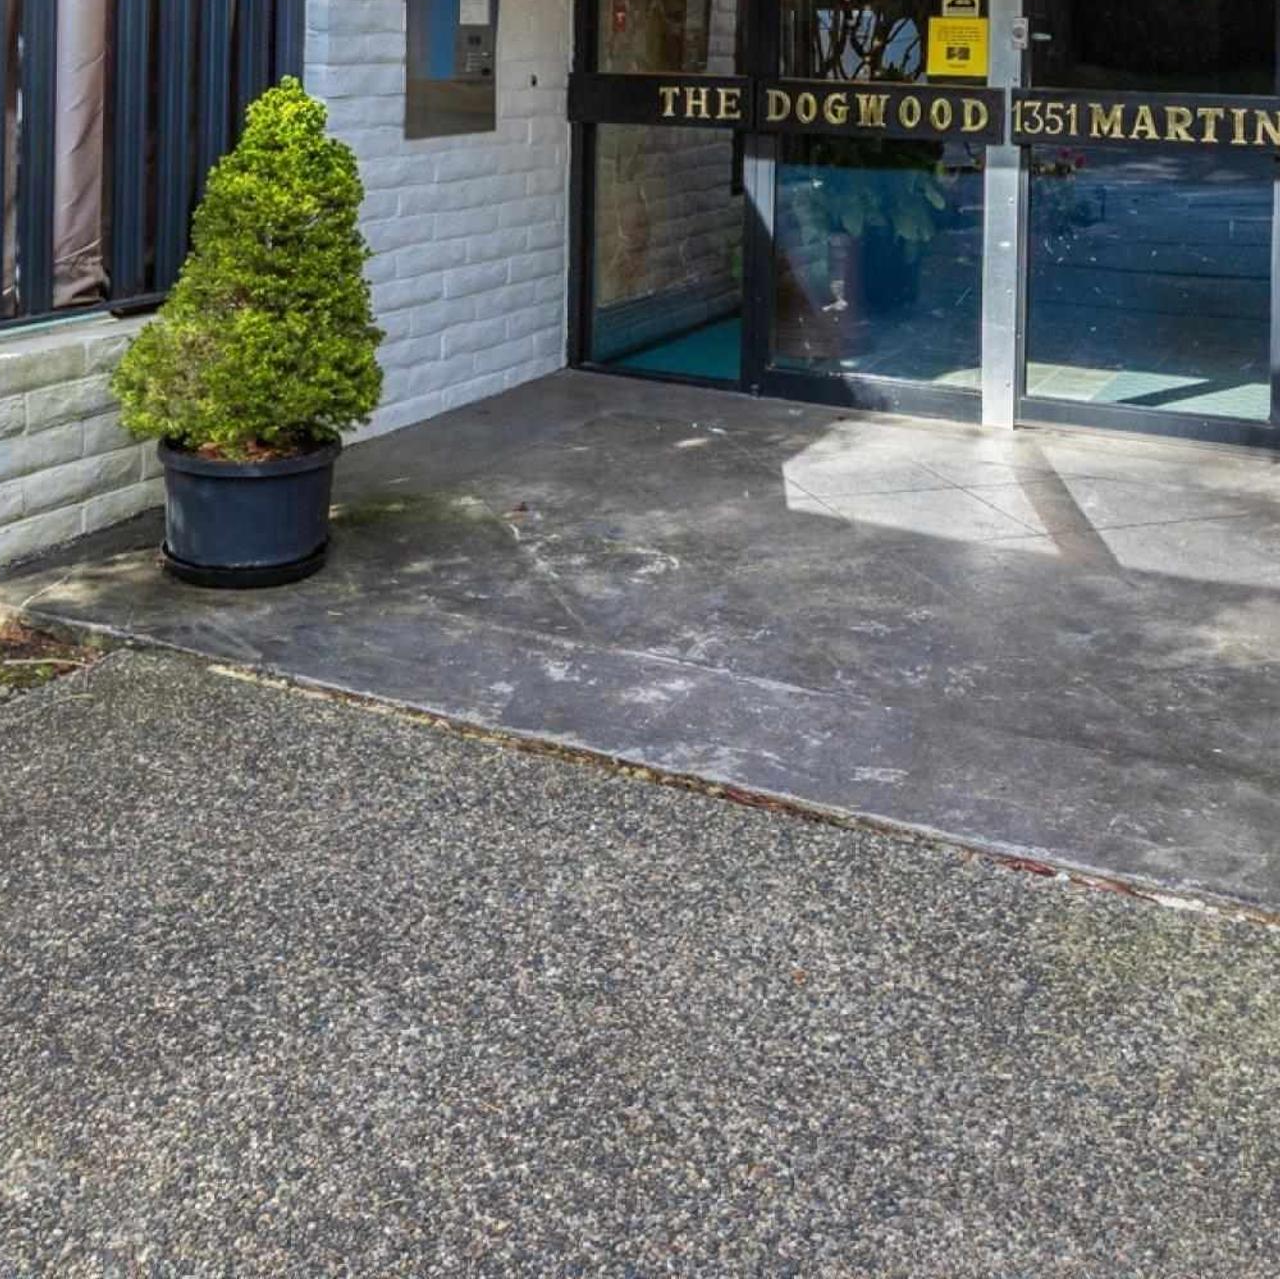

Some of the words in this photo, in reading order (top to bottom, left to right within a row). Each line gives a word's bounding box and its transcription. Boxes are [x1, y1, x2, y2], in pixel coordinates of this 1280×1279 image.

[658, 86, 742, 120] THE
[766, 88, 989, 132] DOGWOOD
[1012, 100, 1078, 136] 1351
